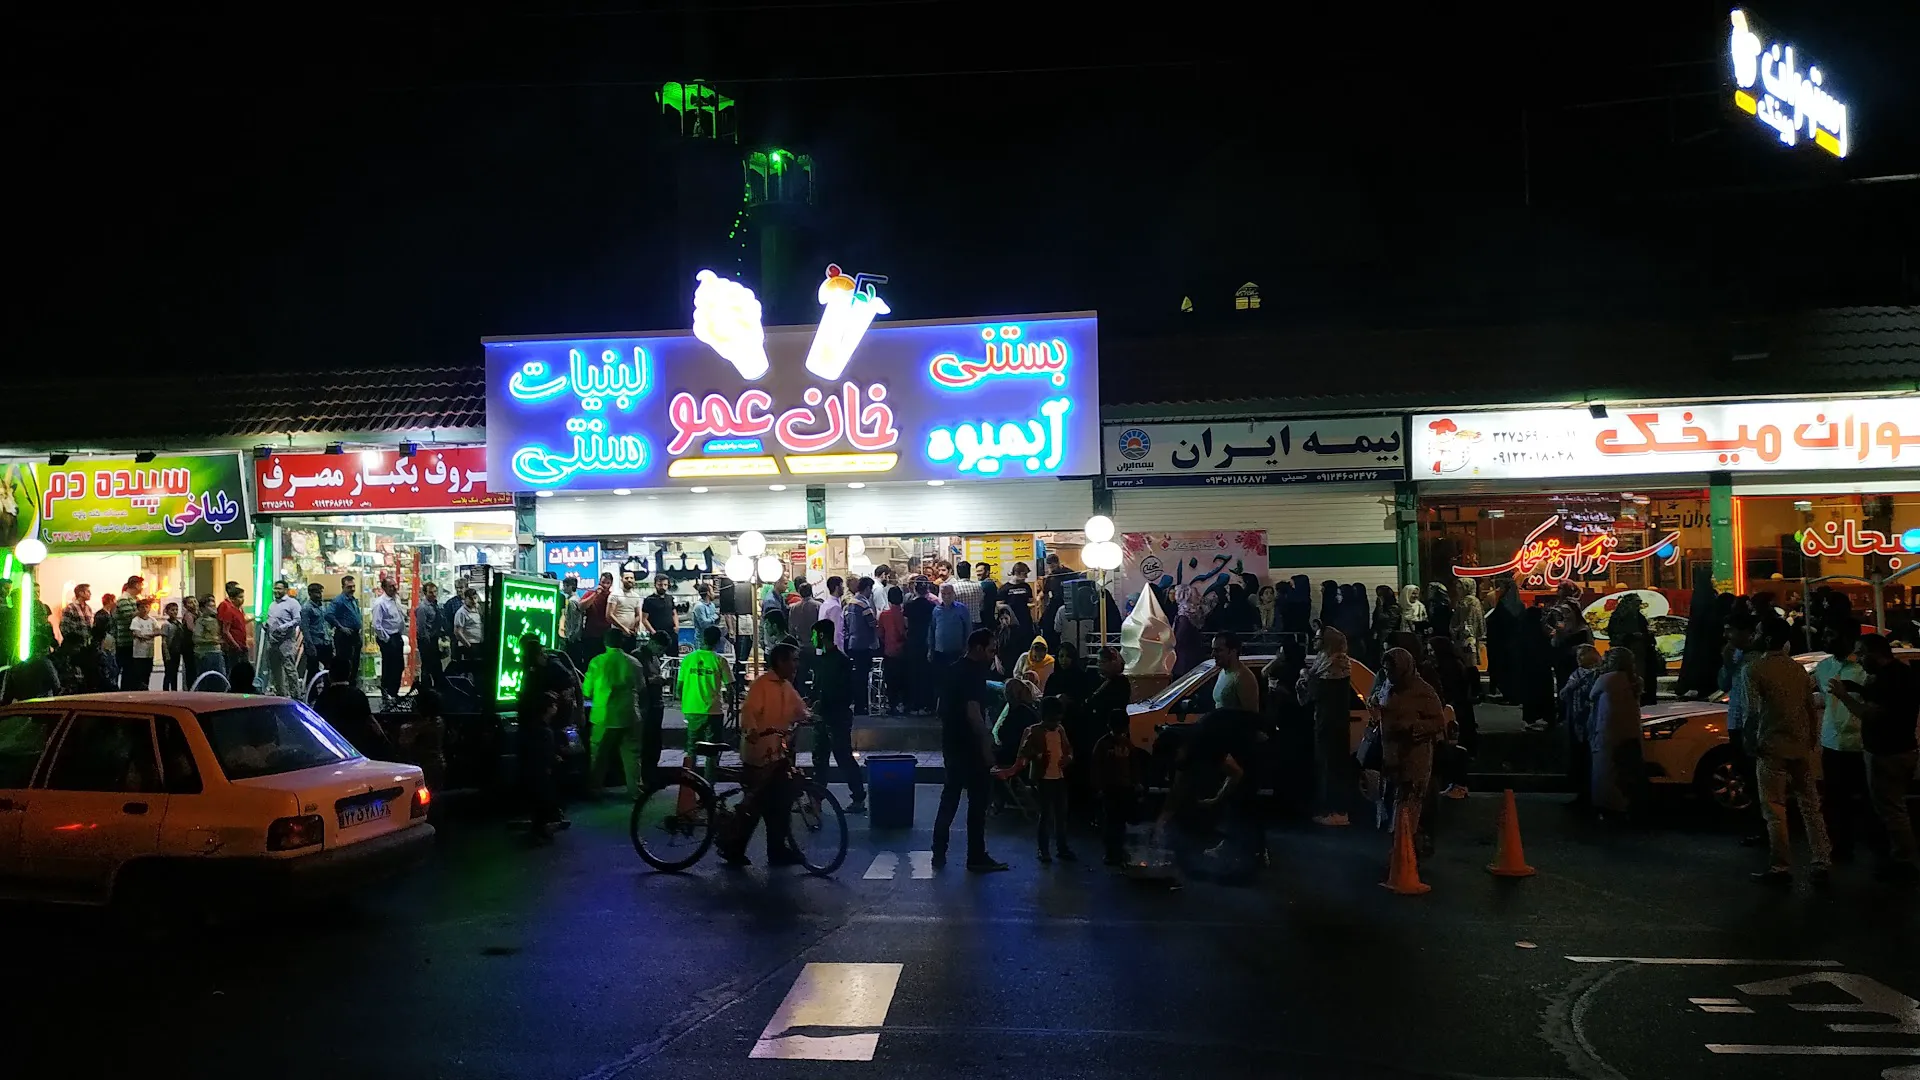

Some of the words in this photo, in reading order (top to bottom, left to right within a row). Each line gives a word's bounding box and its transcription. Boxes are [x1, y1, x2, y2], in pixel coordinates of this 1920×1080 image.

[509, 346, 648, 410] لبنیات
[929, 325, 1067, 386] بستنی
[667, 390, 775, 454] عمو
[775, 381, 899, 452] خان
[928, 397, 1070, 472] آبمیوه
[1595, 412, 1781, 464] میخک
[512, 418, 647, 483] سنتی
[1117, 462, 1135, 472] ایران
[1135, 462, 1154, 471] بیمه
[1171, 424, 1290, 468] ایران
[1303, 429, 1400, 461] بیمه
[43, 471, 87, 519] دم
[94, 467, 191, 514] سپیده
[262, 457, 344, 498] مصرف
[350, 455, 419, 496] یکبار
[424, 452, 487, 493] روف
[164, 490, 239, 535] طباخی
[548, 546, 595, 567] لبنیات
[1453, 514, 1550, 587] میخک
[1544, 531, 1680, 588] رستوران
[1801, 519, 1920, 570] بحانه
